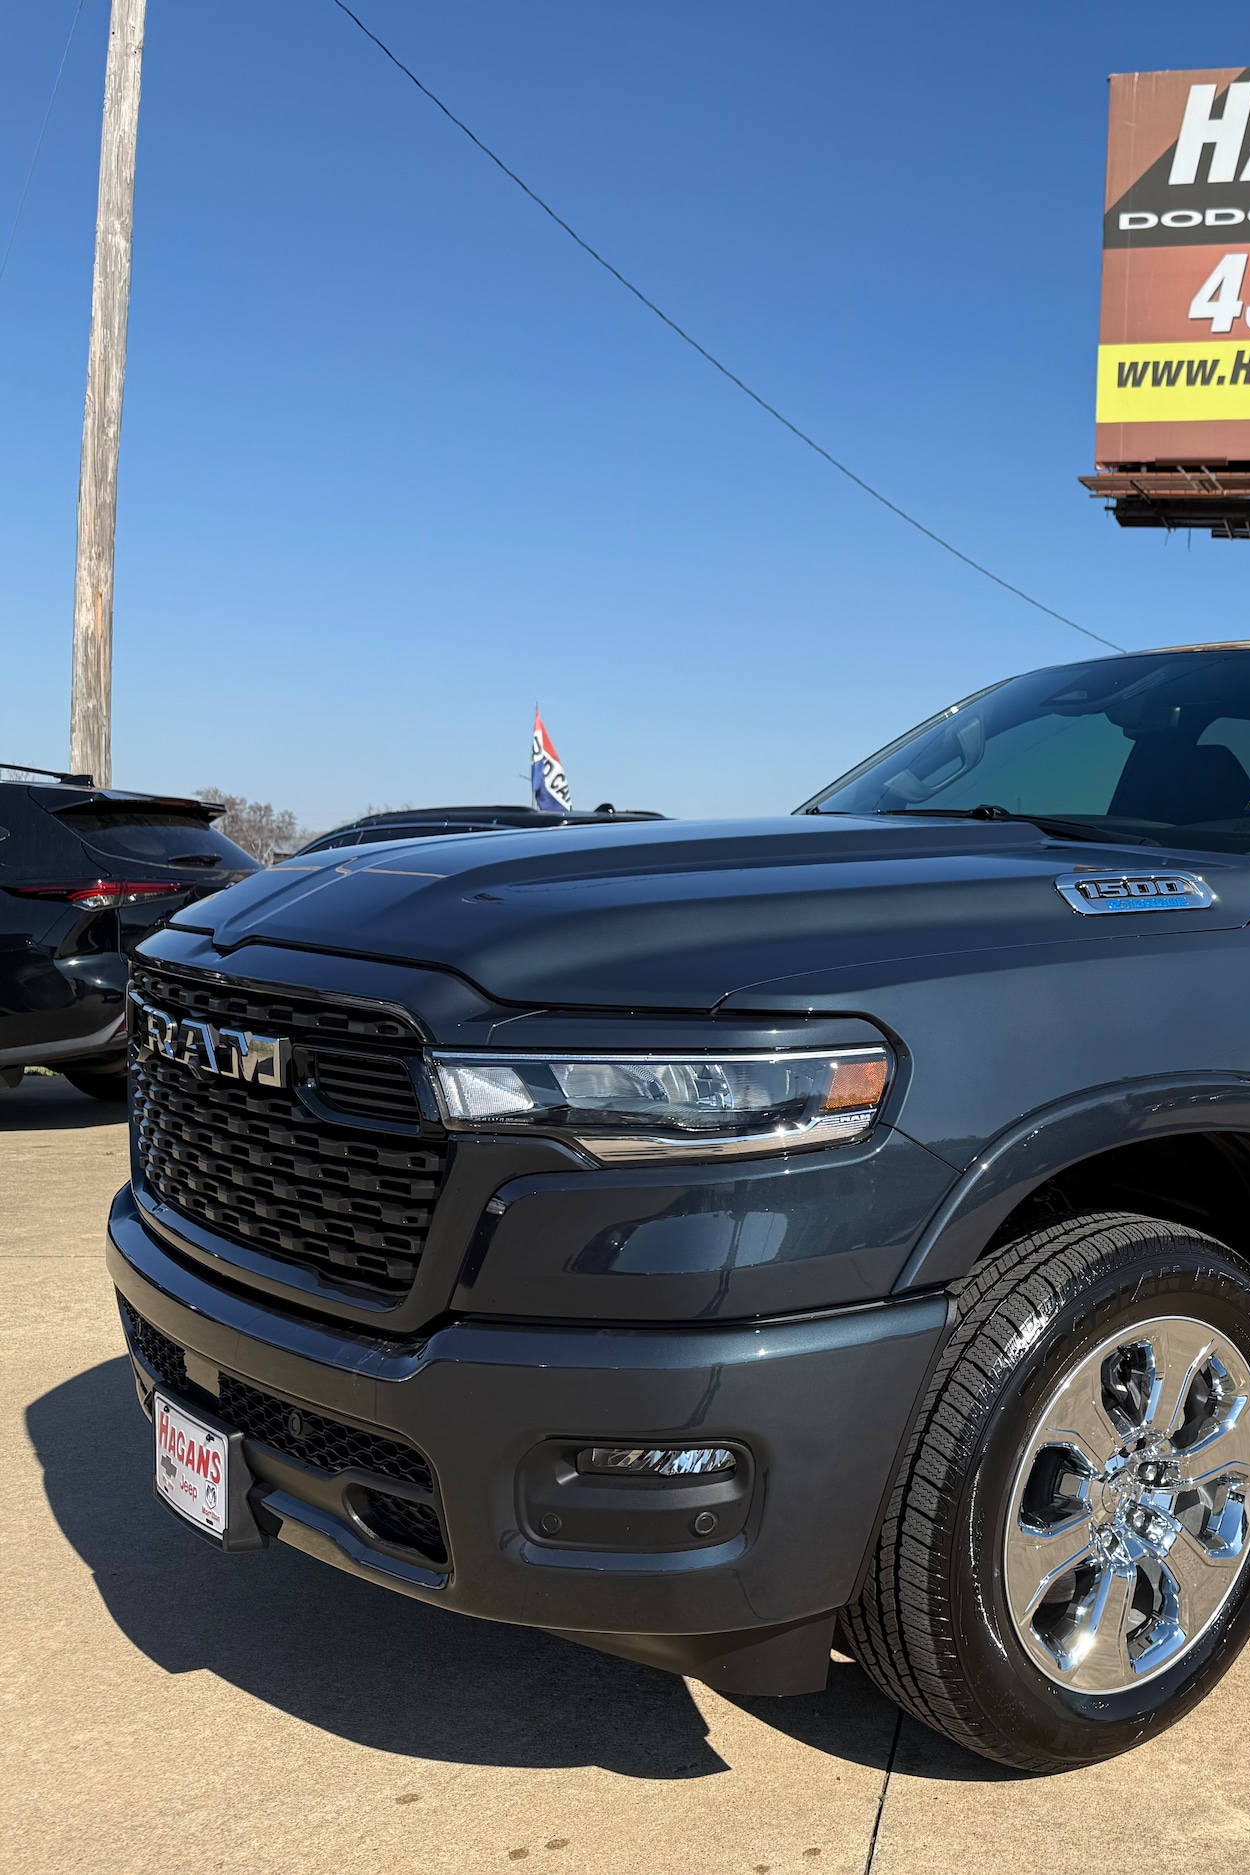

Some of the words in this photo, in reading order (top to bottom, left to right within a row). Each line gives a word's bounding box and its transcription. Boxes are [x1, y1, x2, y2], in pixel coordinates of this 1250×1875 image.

[1083, 880, 1185, 899] 1500
[138, 1003, 292, 1088] RAM
[840, 1114, 870, 1122] RAM
[159, 1411, 222, 1484] HAGANS
[180, 1474, 198, 1501] Jeep
